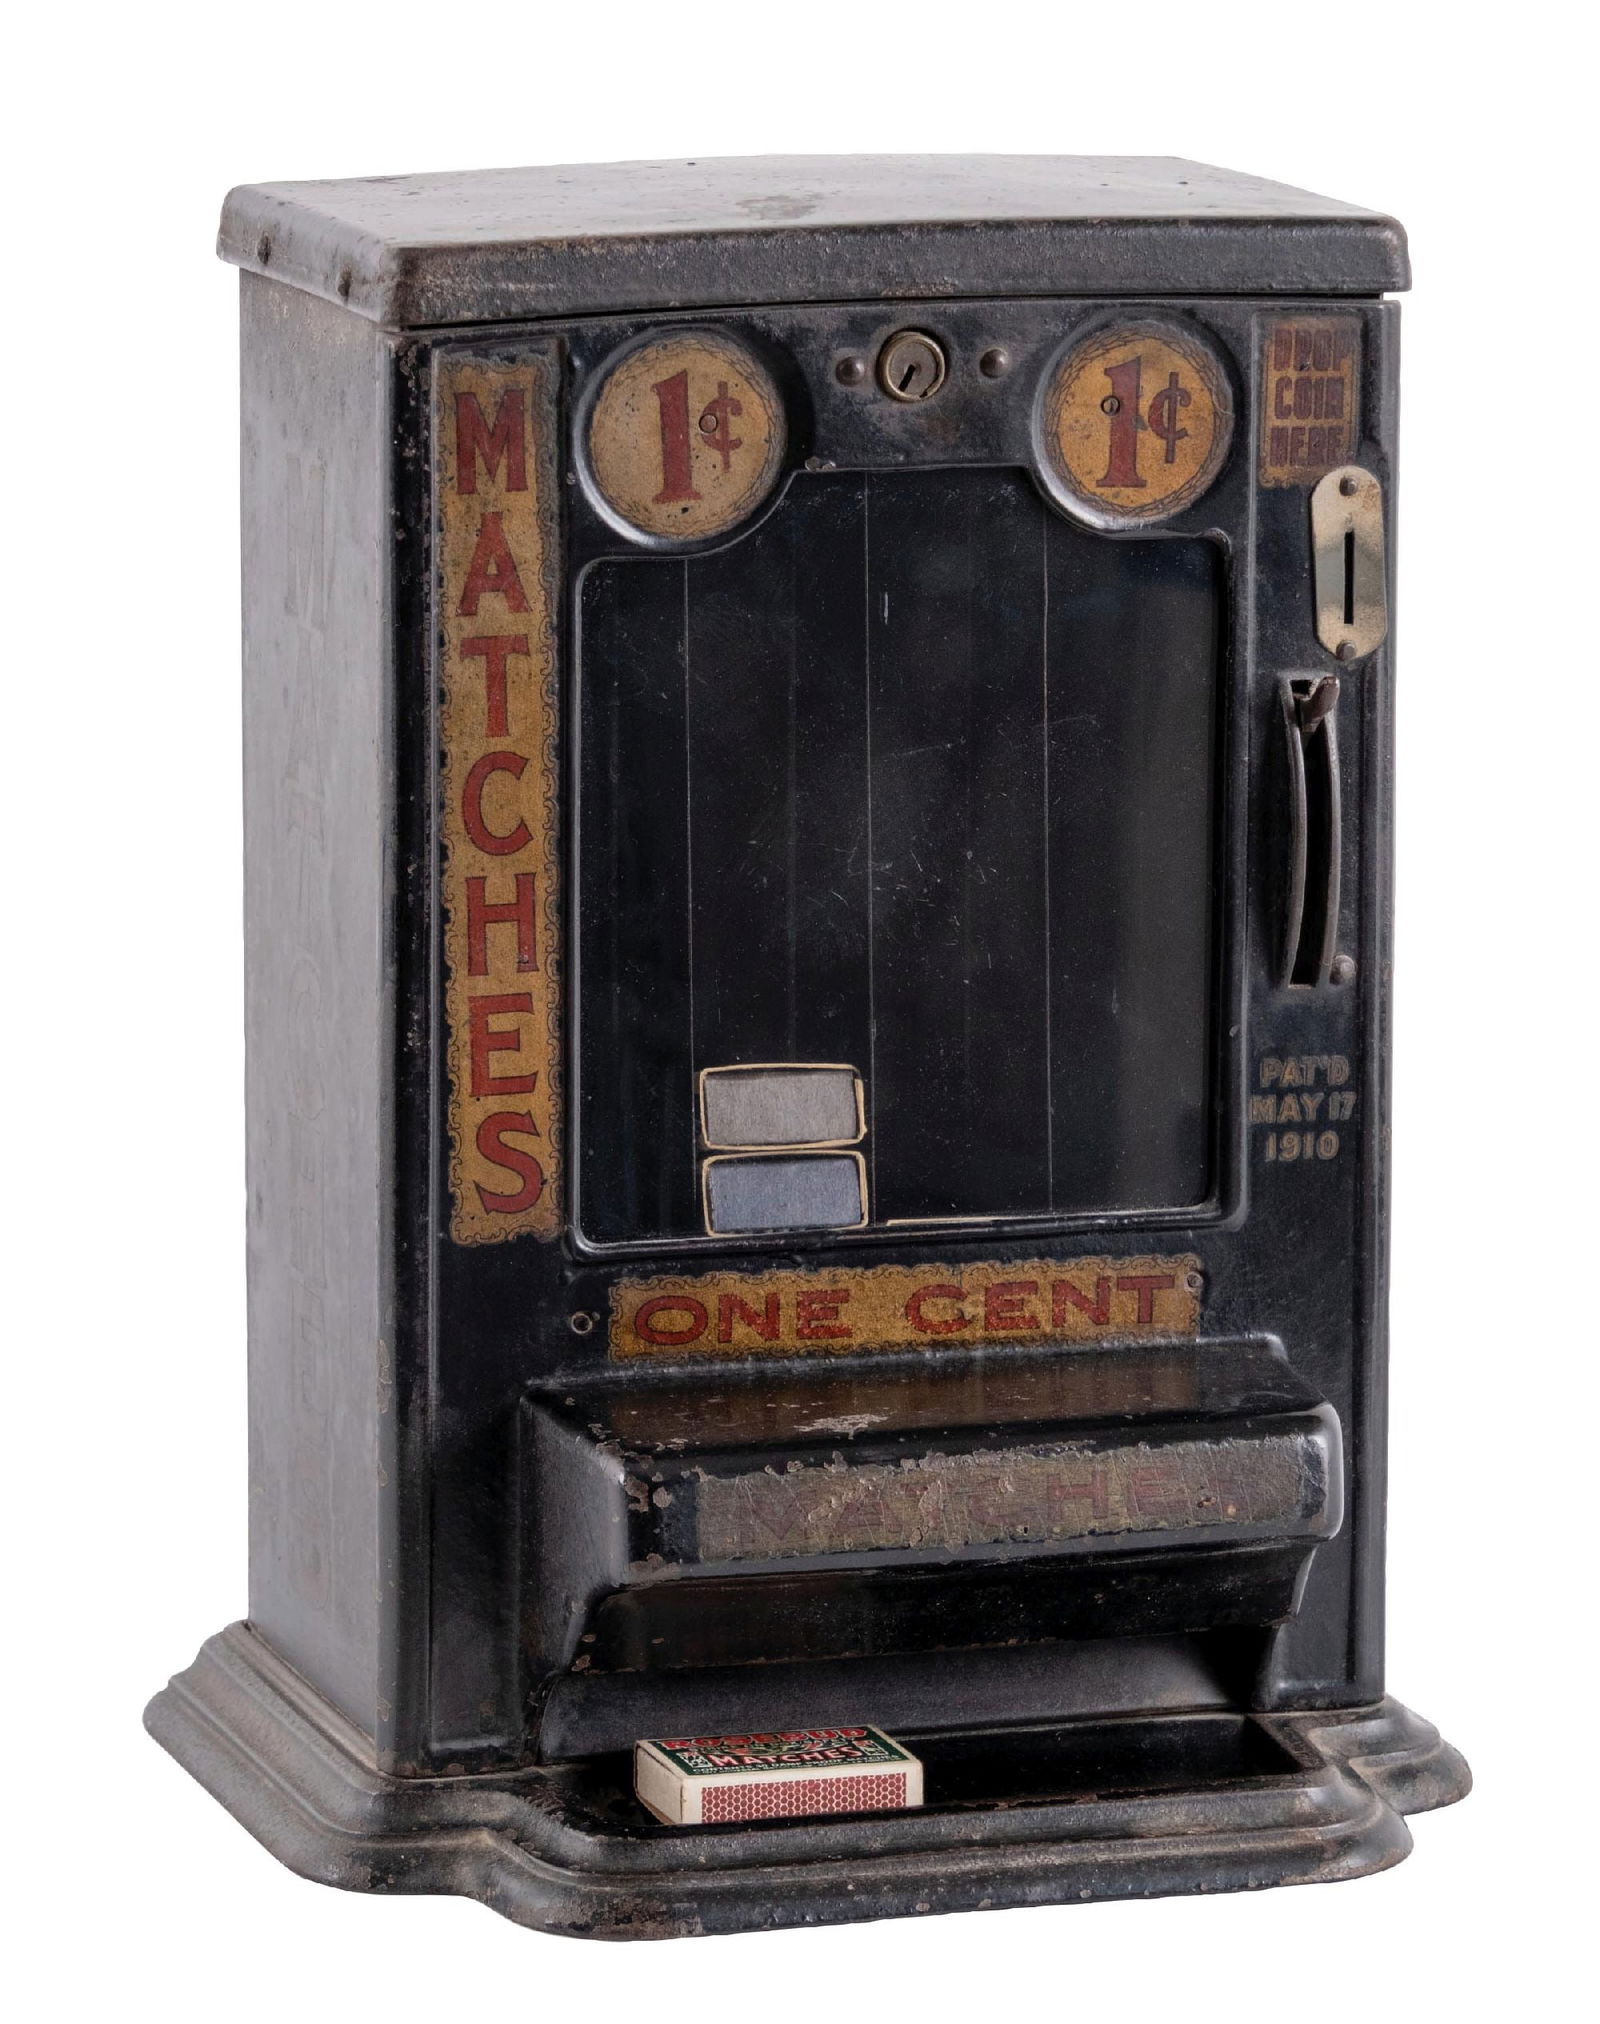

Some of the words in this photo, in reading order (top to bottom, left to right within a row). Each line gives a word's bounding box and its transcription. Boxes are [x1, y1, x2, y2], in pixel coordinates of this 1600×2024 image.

[1274, 376, 1345, 420] COIN
[1269, 426, 1346, 467] HERE
[455, 388, 544, 1215] MATCHES
[1260, 1055, 1349, 1089] PAT'D
[1249, 1091, 1325, 1124] MAY
[1328, 1090, 1357, 1121] 17
[1264, 1130, 1340, 1163] 1910
[634, 1288, 853, 1346] ONE
[905, 1274, 1176, 1335] CENT
[706, 1745, 863, 1767] MATCHES
